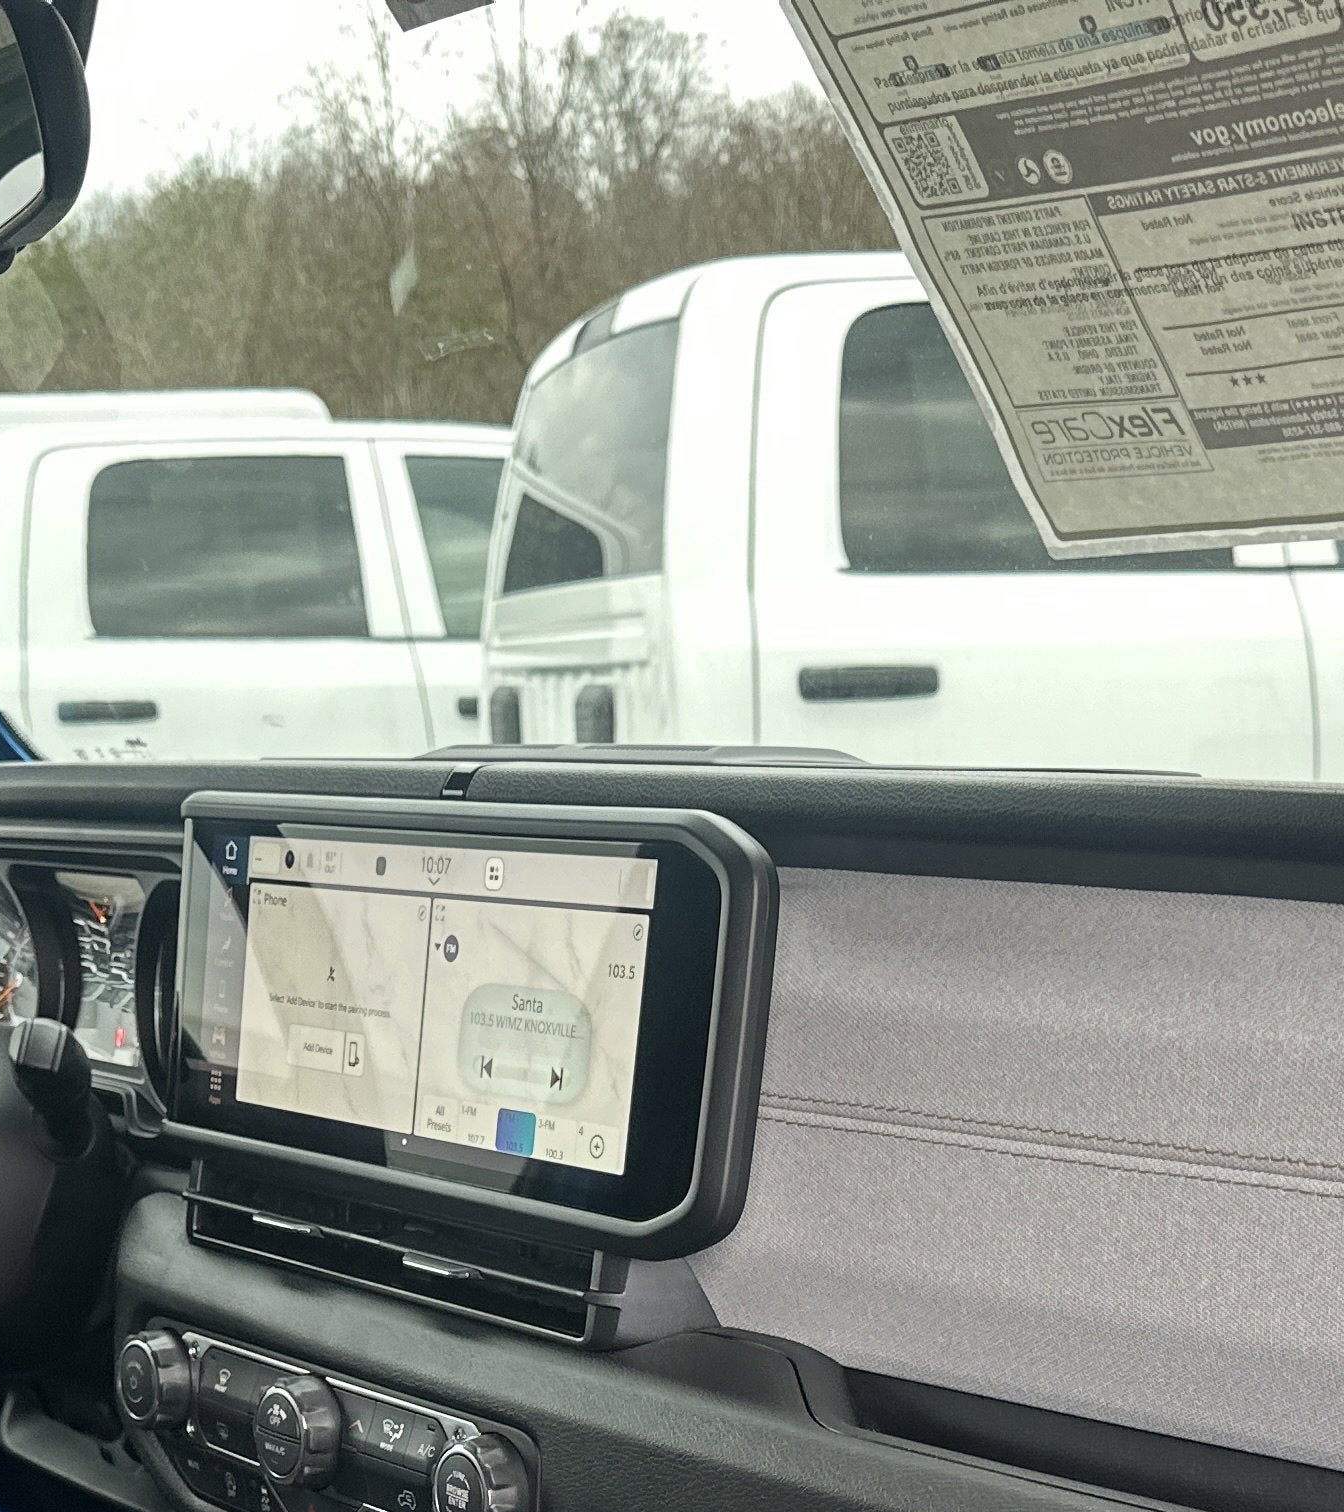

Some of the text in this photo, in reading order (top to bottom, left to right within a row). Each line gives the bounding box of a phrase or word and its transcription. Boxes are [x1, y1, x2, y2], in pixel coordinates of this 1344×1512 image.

[1246, 12, 1296, 39] cristal.
[1230, 267, 1255, 284] des
[976, 281, 998, 298] Afin
[422, 856, 452, 875] 10:07
[263, 893, 288, 906] Phone
[444, 943, 457, 955] FM
[608, 963, 635, 980] 103.5
[511, 993, 543, 1014] Santa
[470, 1011, 495, 1026] 103.5
[496, 1015, 523, 1031] WIMZ
[436, 1105, 445, 1117] All
[427, 1118, 452, 1133] Presets
[538, 1118, 555, 1130] 3-FM
[417, 1443, 436, 1457] A/C
